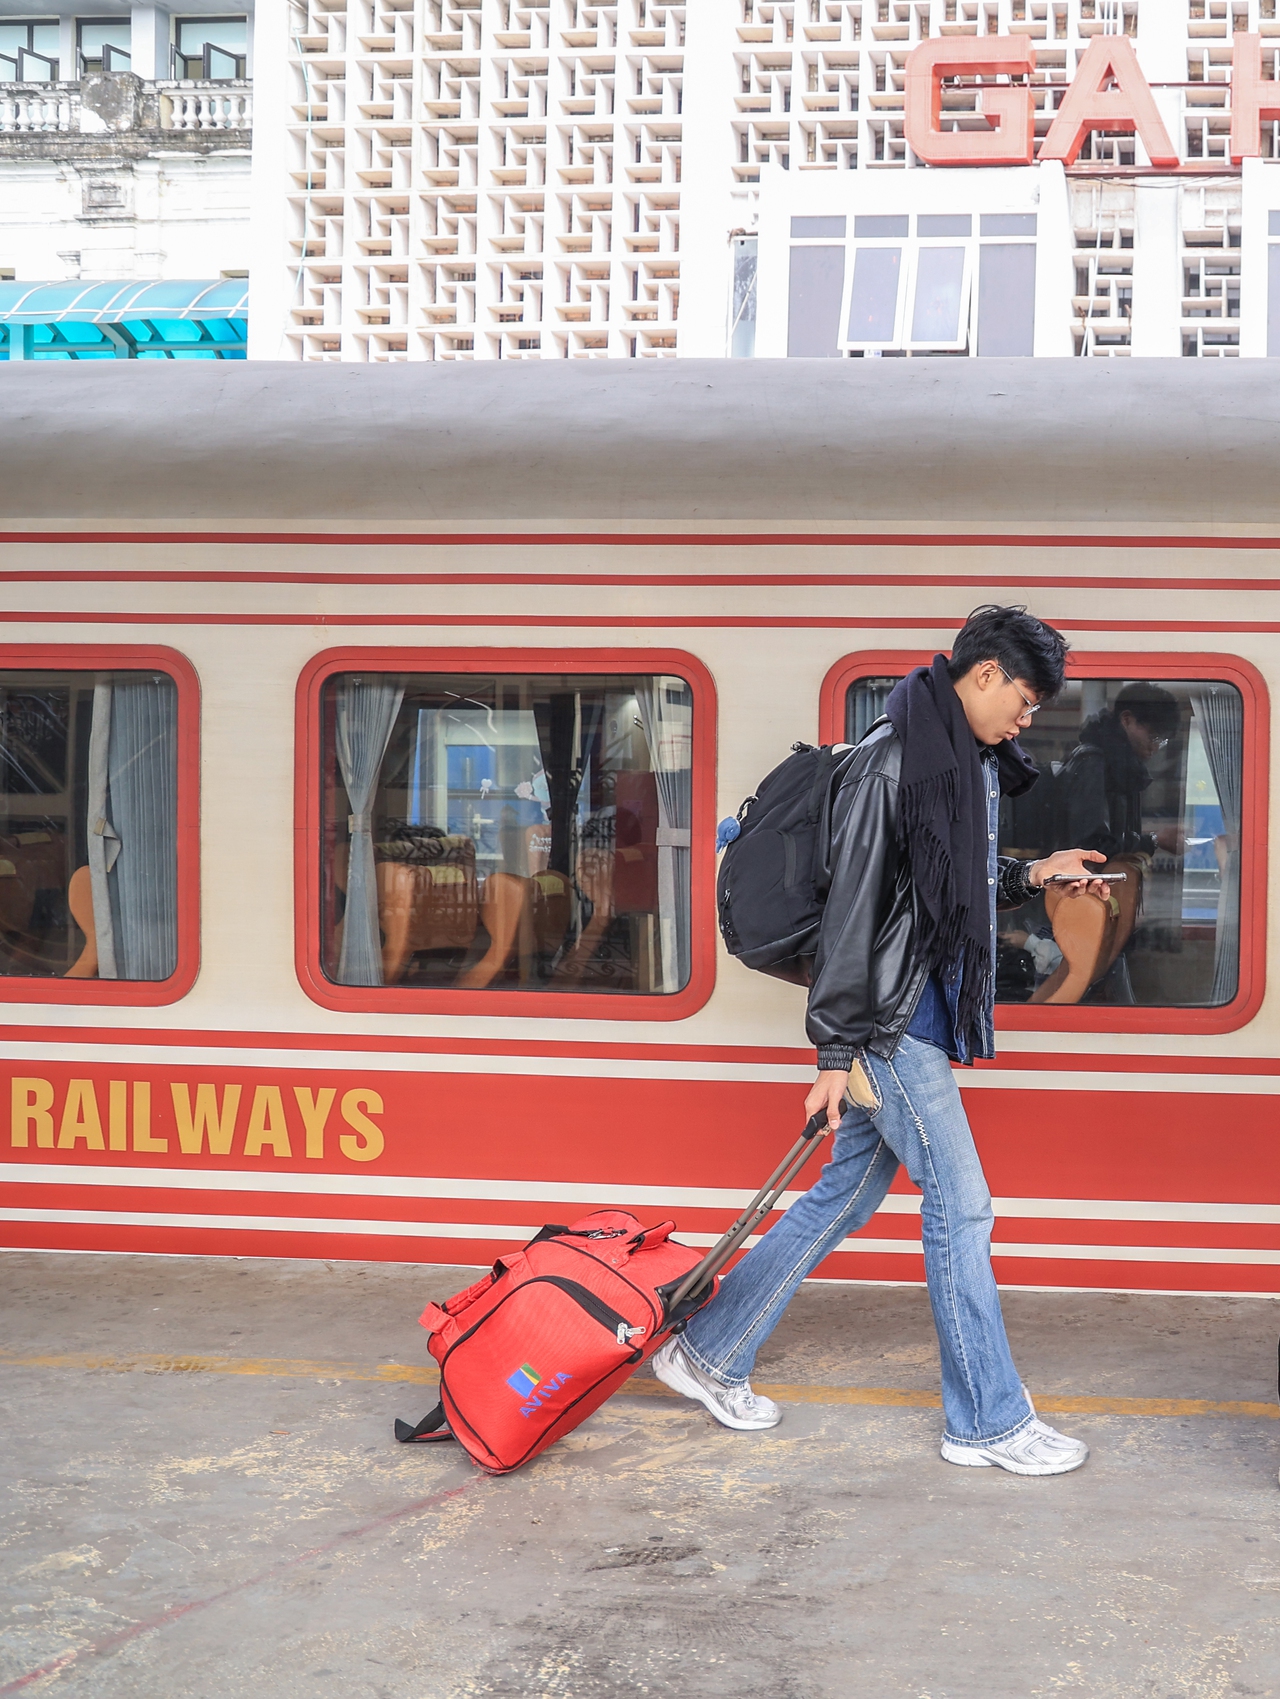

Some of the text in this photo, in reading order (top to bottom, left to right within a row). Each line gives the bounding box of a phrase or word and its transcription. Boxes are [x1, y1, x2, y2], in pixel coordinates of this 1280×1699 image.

[905, 34, 1180, 167] GA
[10, 1076, 386, 1163] RAILWAYS
[519, 1371, 574, 1419] AVIVA
